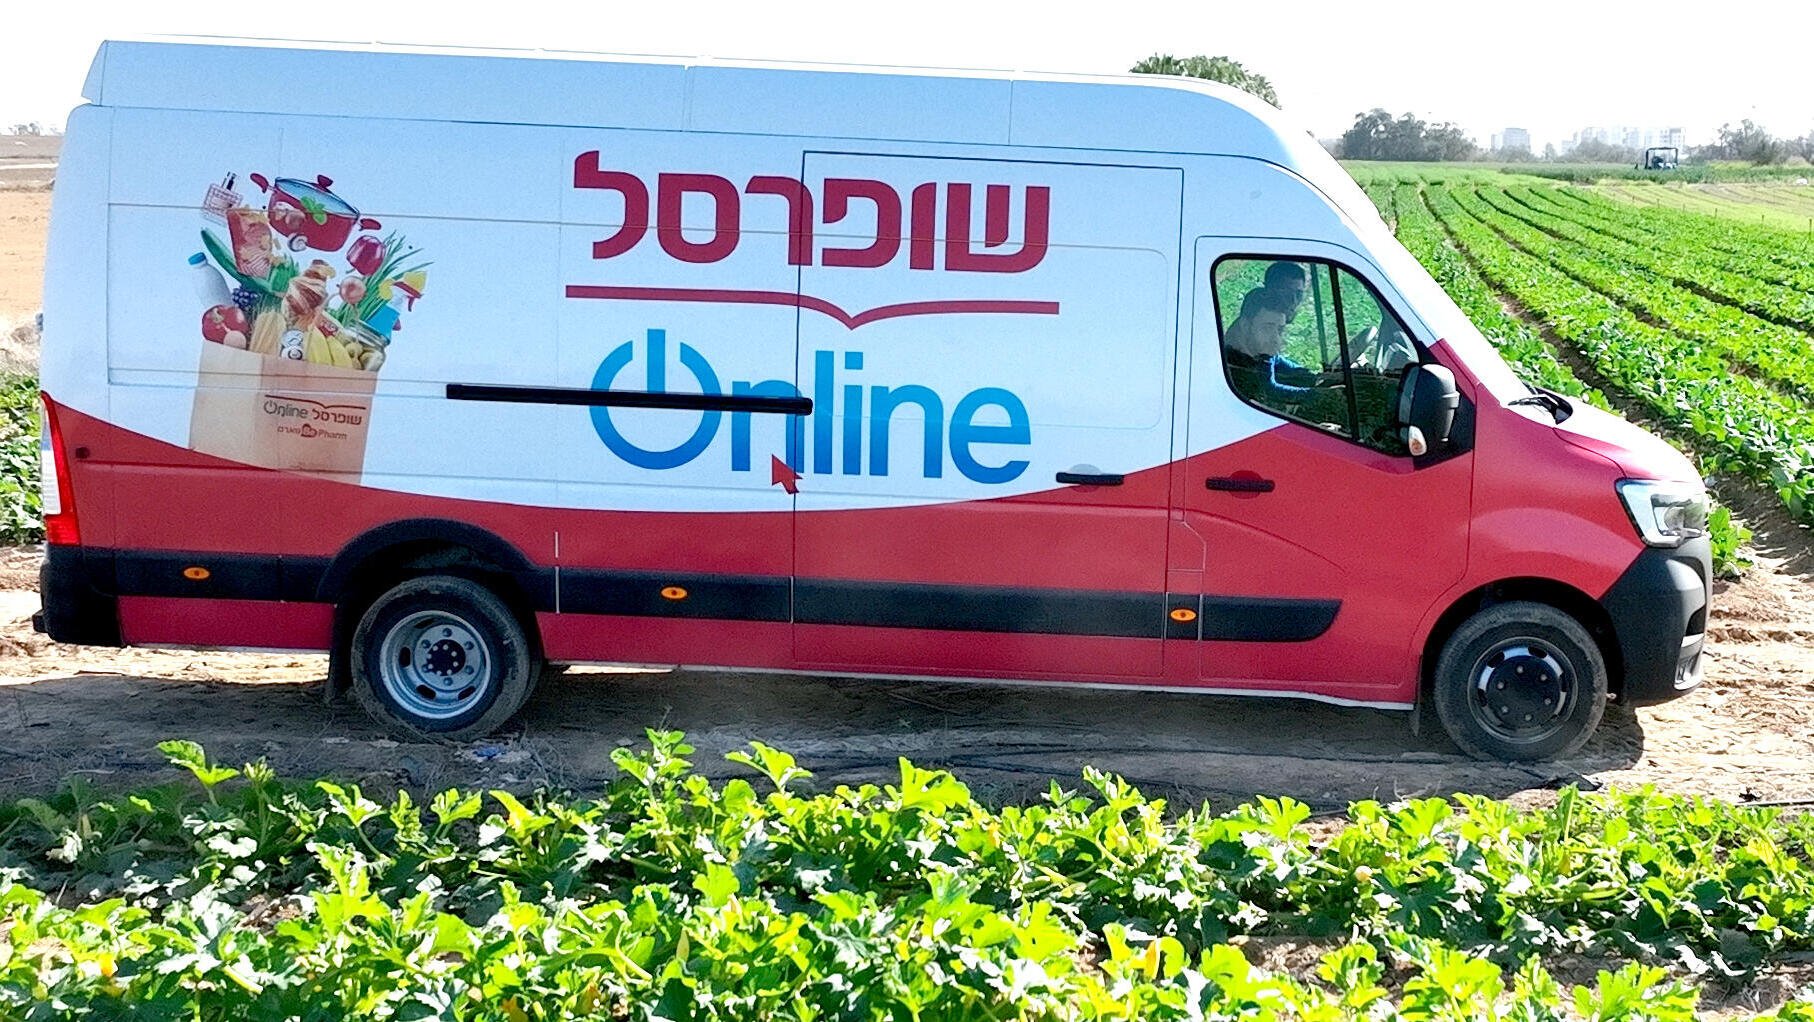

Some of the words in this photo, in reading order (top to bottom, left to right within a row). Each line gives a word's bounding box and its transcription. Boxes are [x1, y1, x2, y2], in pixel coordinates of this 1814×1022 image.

[574, 150, 1050, 273] שופרסל
[263, 400, 308, 419] Online
[312, 408, 362, 425] שופרסל
[589, 329, 1031, 484] Online
